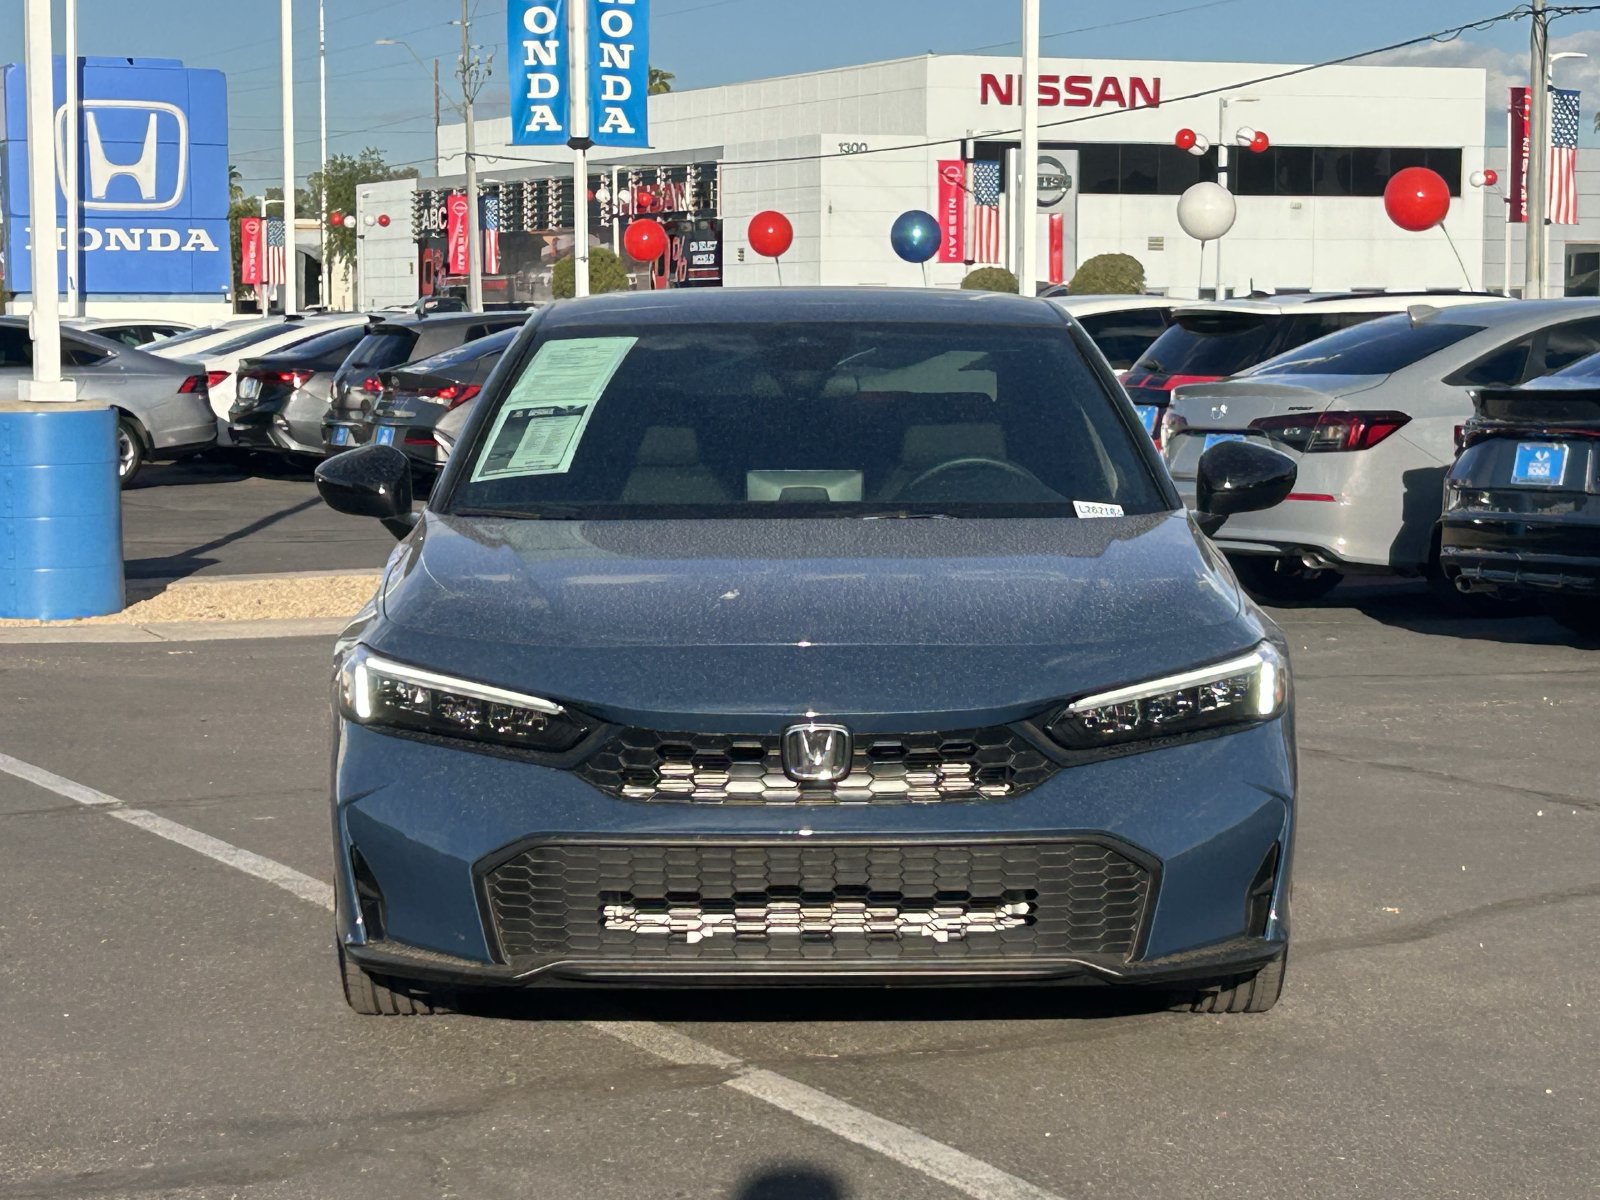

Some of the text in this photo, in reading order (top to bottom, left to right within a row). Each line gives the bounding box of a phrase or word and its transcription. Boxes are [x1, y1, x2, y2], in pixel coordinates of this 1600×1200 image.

[598, 0, 636, 134] ONDA
[838, 142, 869, 154] 1300
[421, 206, 447, 230] ABC
[948, 198, 957, 258] NISSAN
